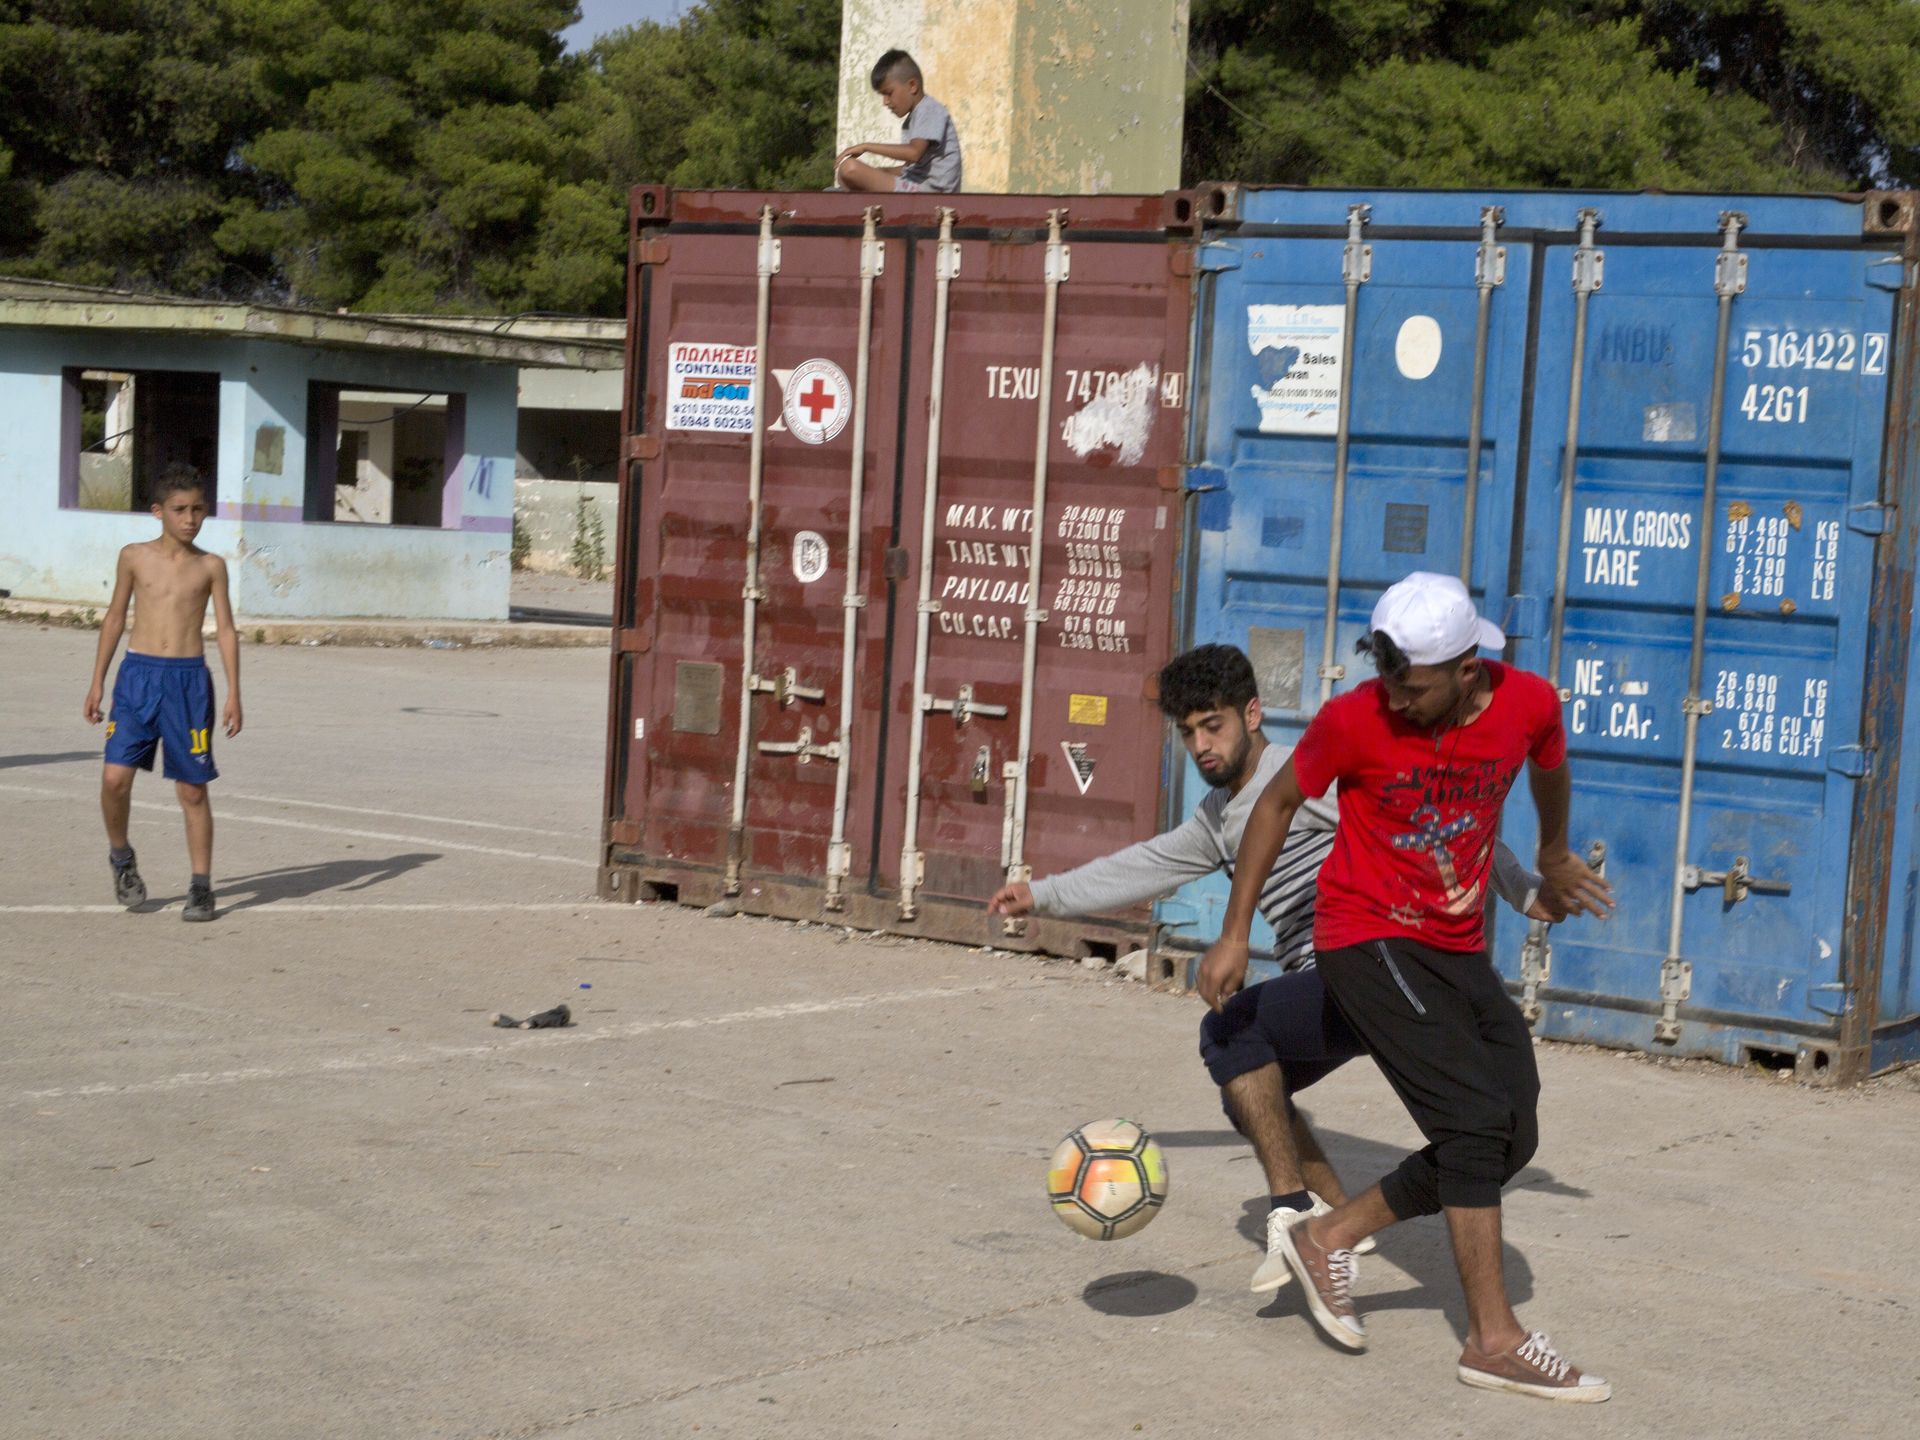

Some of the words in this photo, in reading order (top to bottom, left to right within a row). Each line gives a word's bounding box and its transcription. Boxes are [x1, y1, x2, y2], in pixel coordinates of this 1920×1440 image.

[1303, 353, 1336, 365] Sales
[1741, 331, 1856, 371] 516422
[1864, 335, 1884, 372] 2
[986, 366, 1040, 400] TEXU
[1740, 383, 1809, 424] 42G1
[945, 504, 997, 530] MAX.
[1106, 508, 1126, 525] KG
[1104, 524, 1120, 542] LB
[1816, 520, 1840, 542] KG
[945, 540, 998, 566] TARE
[1103, 544, 1120, 561] KG
[1814, 540, 1837, 560] LB
[1106, 561, 1122, 579] LB
[1582, 548, 1640, 587] TARE
[1812, 560, 1836, 581] KG
[941, 576, 1030, 605] PAYLOAD
[1103, 582, 1121, 599] KG
[1811, 580, 1834, 600] LB
[1097, 598, 1117, 615] LB
[1804, 678, 1828, 699] KG
[1803, 697, 1826, 718] LB
